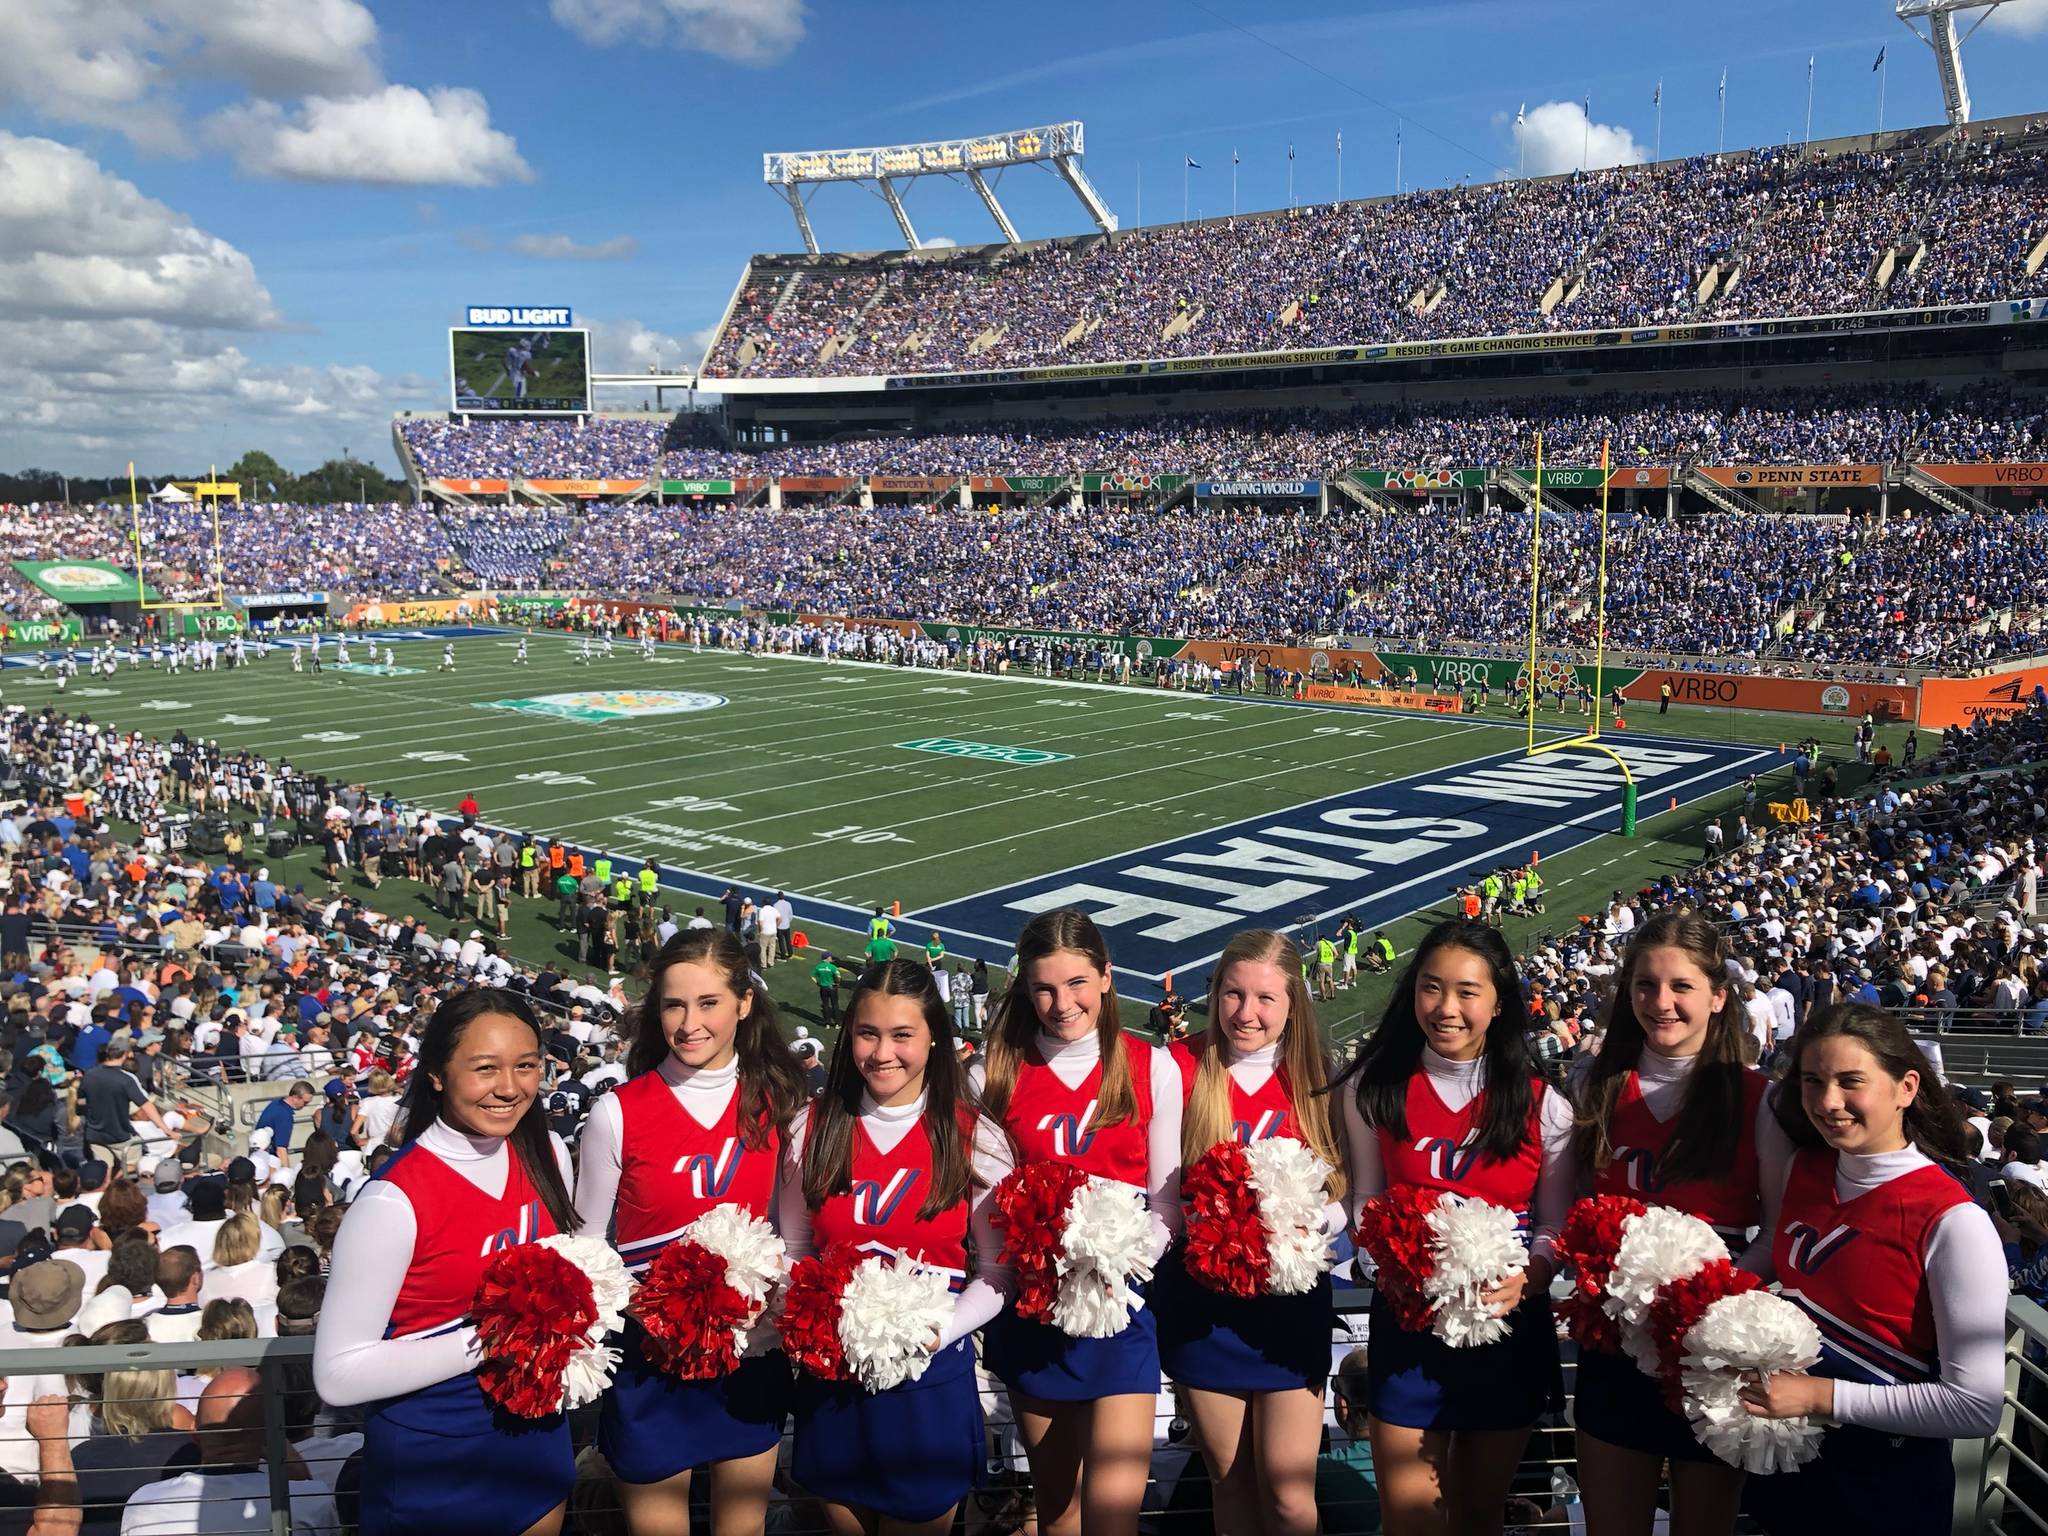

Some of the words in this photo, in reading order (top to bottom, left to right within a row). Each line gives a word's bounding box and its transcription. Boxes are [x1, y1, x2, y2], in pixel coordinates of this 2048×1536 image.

[470, 309, 514, 324] BUD
[514, 309, 569, 324] LIGHT
[1830, 318, 1866, 330] 12:48
[1923, 313, 1932, 324] 0
[1767, 324, 1775, 334] 0
[1396, 344, 1448, 356] RESIDEE
[1450, 342, 1480, 354] GAME
[1482, 338, 1541, 351] CHANGING
[1544, 335, 1594, 347] SERVICE!
[1173, 359, 1216, 370] RESIDEE
[1218, 358, 1242, 368] GAME
[1244, 354, 1292, 366] CHANGING
[1294, 351, 1336, 362] SERVICE!
[1049, 368, 1089, 378] CHANGING
[1090, 366, 1124, 376] SERVICE!
[1547, 473, 1583, 485] VRBO
[1758, 470, 1804, 482] PENN
[1809, 470, 1862, 482] STATE
[1995, 468, 2043, 482] VRBO
[683, 482, 710, 492] VRBO
[882, 480, 925, 489] KENTUCKY
[1021, 479, 1044, 489] VRBO
[1210, 482, 1260, 496] CAMPING
[1261, 482, 1305, 495] WORLD
[195, 617, 236, 633] VBO
[20, 626, 67, 643] VRO
[1223, 646, 1272, 668] VRBO
[1431, 660, 1490, 684] VRBO
[1312, 689, 1336, 699] VRBO
[1670, 677, 1738, 702] VRBO
[1964, 706, 2016, 716] CAMPING
[916, 740, 1056, 762] VRBO
[515, 770, 586, 785] 30
[1413, 744, 1714, 808] PENN
[648, 796, 729, 812] 20
[612, 815, 706, 837] CAMPING
[700, 833, 783, 852] WORLD
[614, 829, 713, 852] STADIUM
[812, 825, 896, 844] 10
[1003, 806, 1490, 944] STATE
[1784, 1002, 1790, 1019] 1
